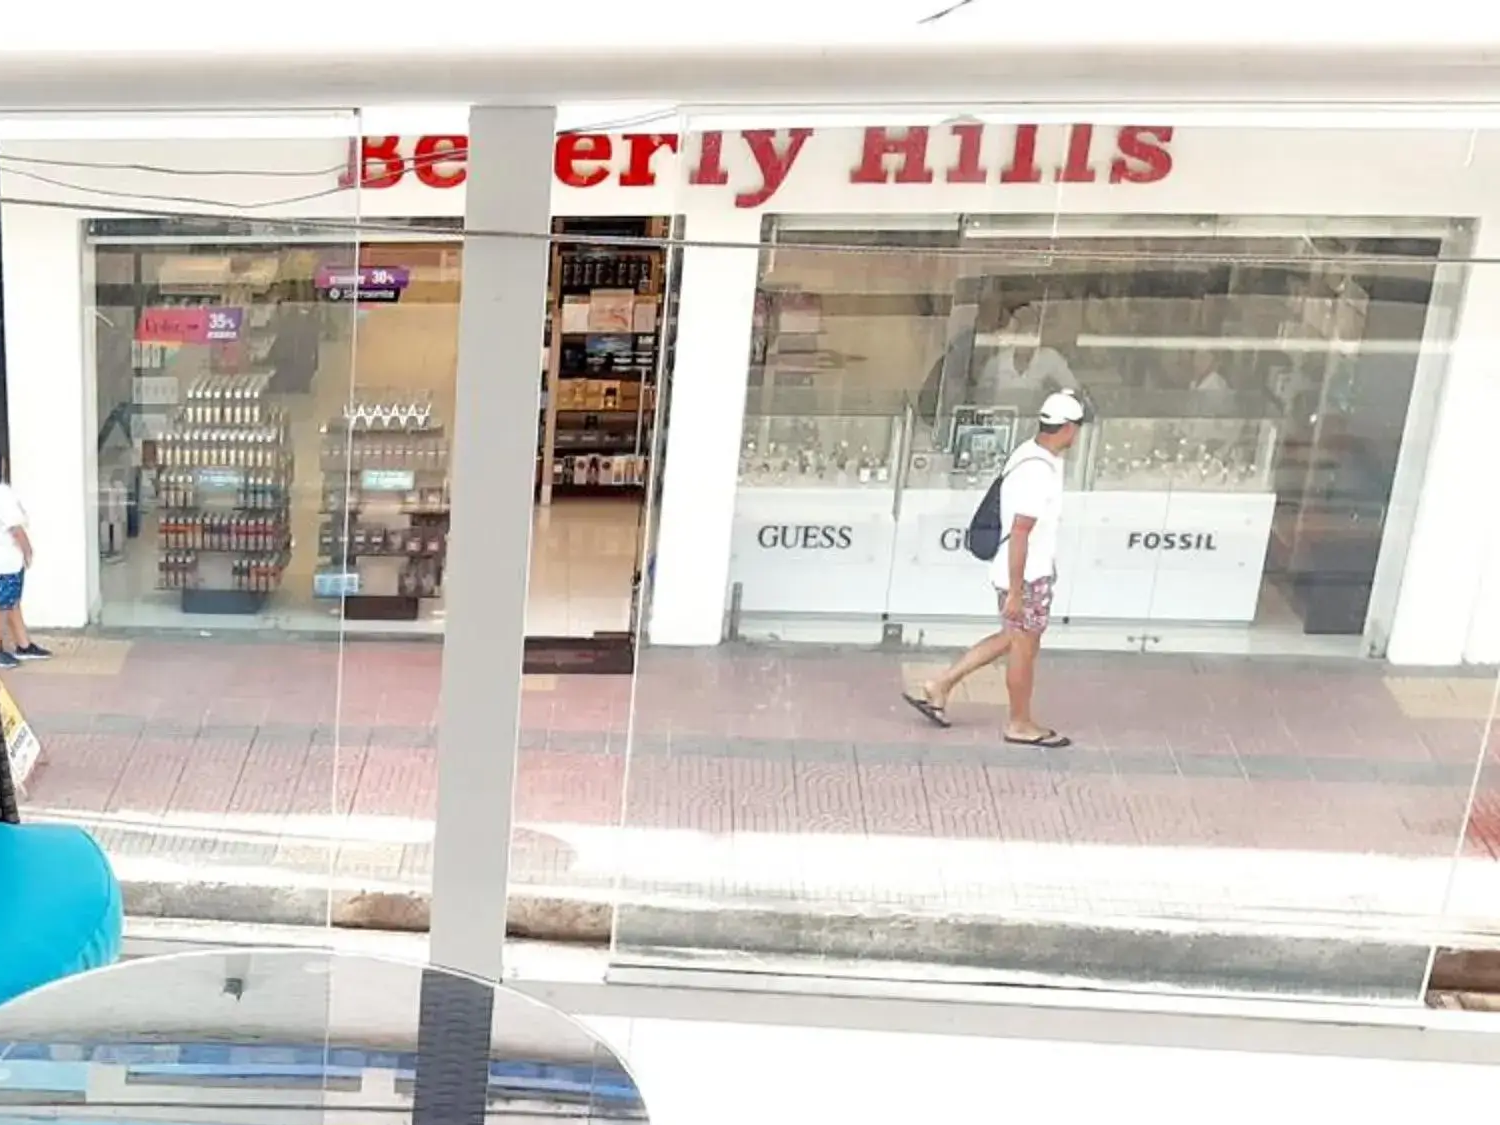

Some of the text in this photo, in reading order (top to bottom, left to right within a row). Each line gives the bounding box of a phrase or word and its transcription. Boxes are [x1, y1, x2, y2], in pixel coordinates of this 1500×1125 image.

[339, 124, 1173, 208] Beerly Hills
[757, 525, 853, 549] GUESS
[1127, 531, 1217, 551] FOSSIL
